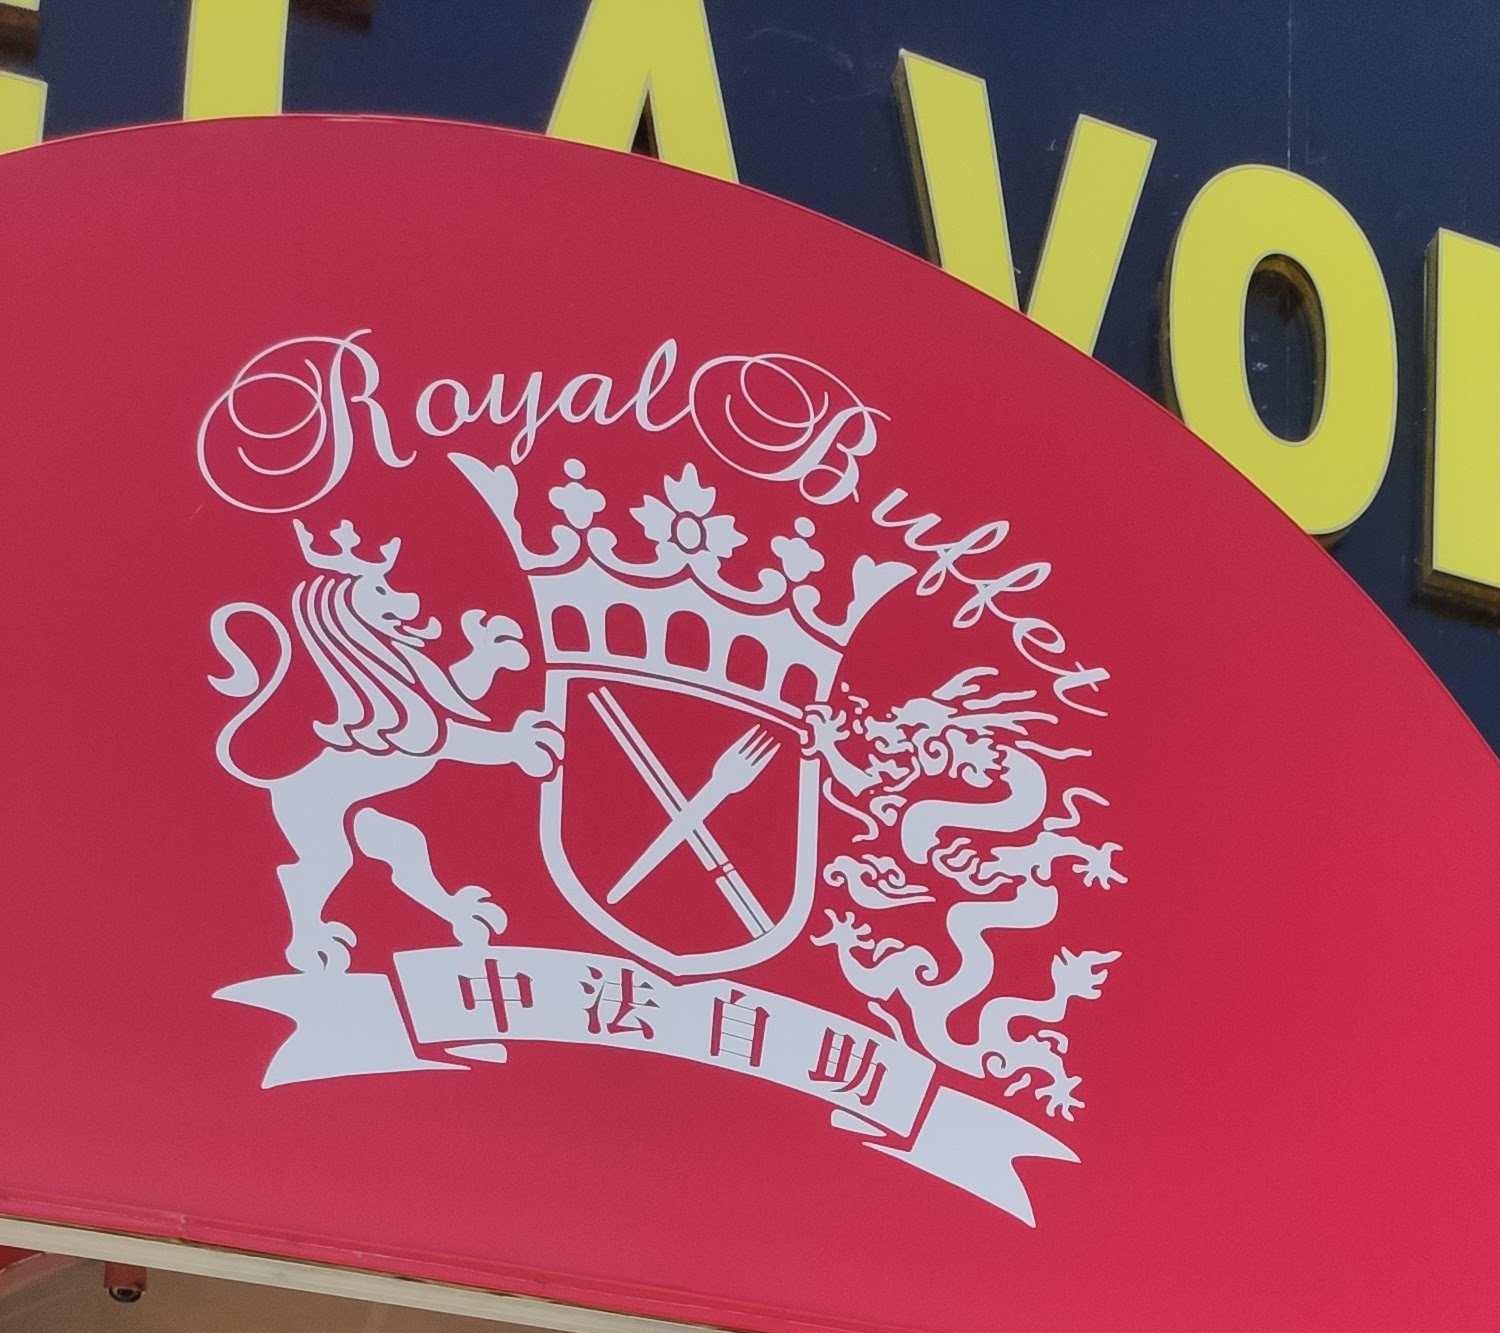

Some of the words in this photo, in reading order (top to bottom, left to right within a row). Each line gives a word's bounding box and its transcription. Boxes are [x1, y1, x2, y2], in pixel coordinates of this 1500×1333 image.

[197, 329, 693, 513] Royal
[689, 353, 1110, 717] Buffet
[458, 957, 887, 1110] 中法自助
